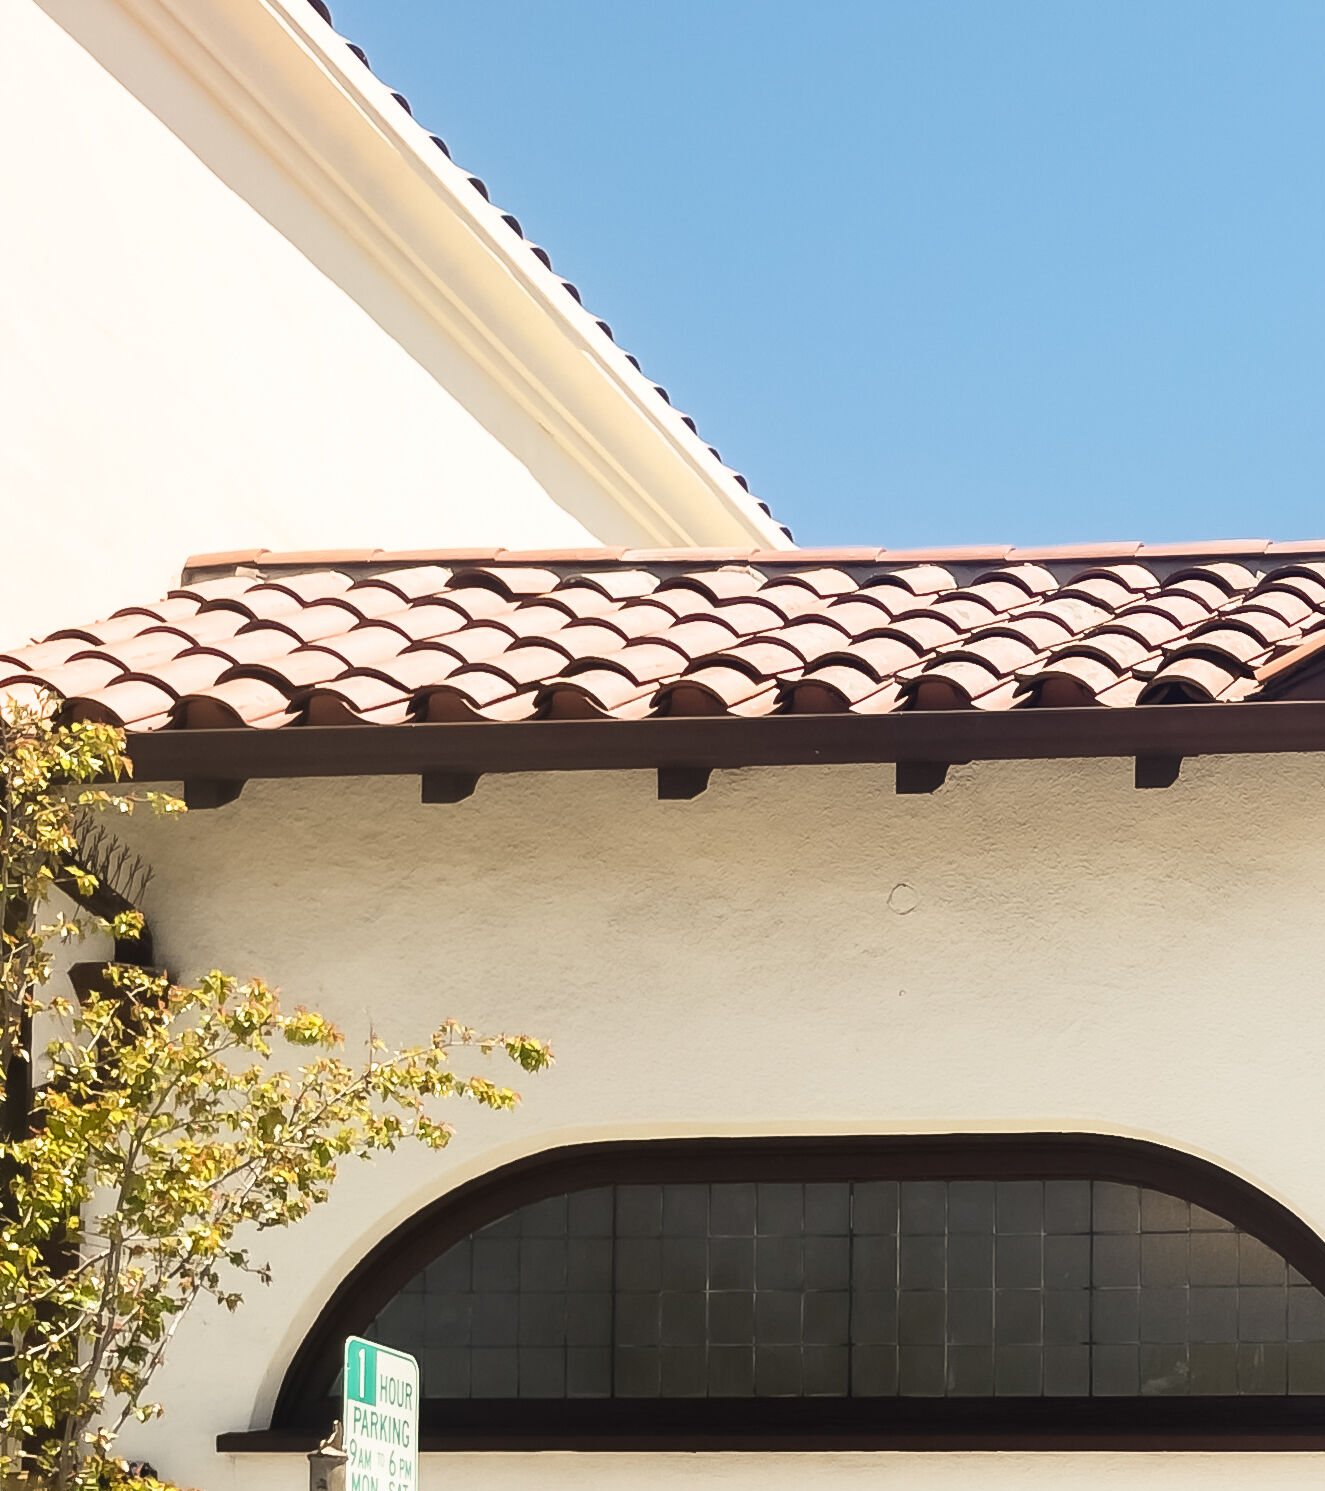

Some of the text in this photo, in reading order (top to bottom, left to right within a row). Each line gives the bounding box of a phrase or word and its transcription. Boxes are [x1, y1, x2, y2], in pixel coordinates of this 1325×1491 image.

[357, 1348, 413, 1411] 1 HOUR
[353, 1406, 411, 1449] PARKING
